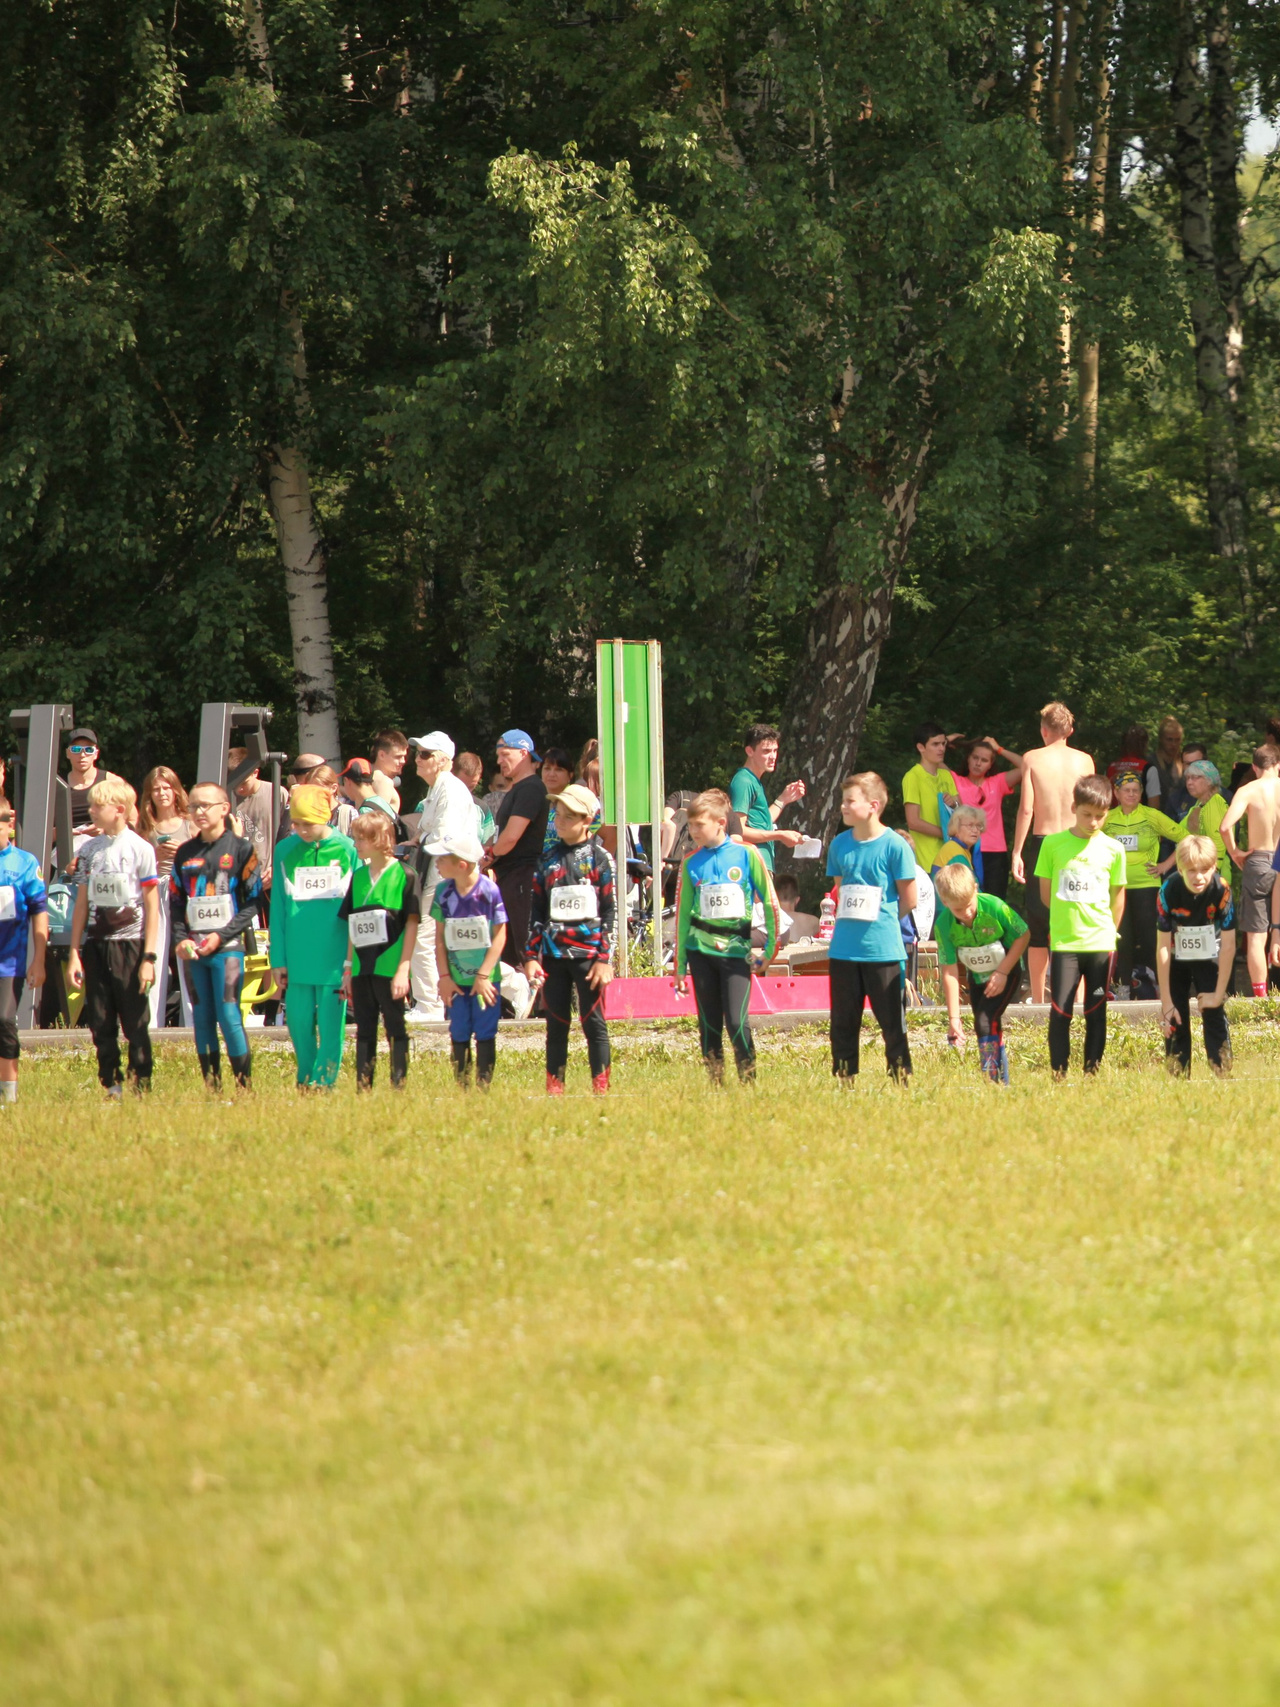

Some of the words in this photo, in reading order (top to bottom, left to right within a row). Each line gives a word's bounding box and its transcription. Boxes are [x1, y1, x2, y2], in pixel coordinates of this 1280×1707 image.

[96, 883, 116, 893] 641
[305, 879, 326, 889] 643
[1068, 880, 1089, 891] 654
[559, 899, 581, 910] 646
[709, 896, 730, 907] 653
[846, 897, 866, 908] 647
[198, 908, 220, 919] 644
[357, 922, 375, 934] 639
[456, 929, 478, 940] 645
[1181, 938, 1202, 949] 655
[969, 955, 992, 965] 652
